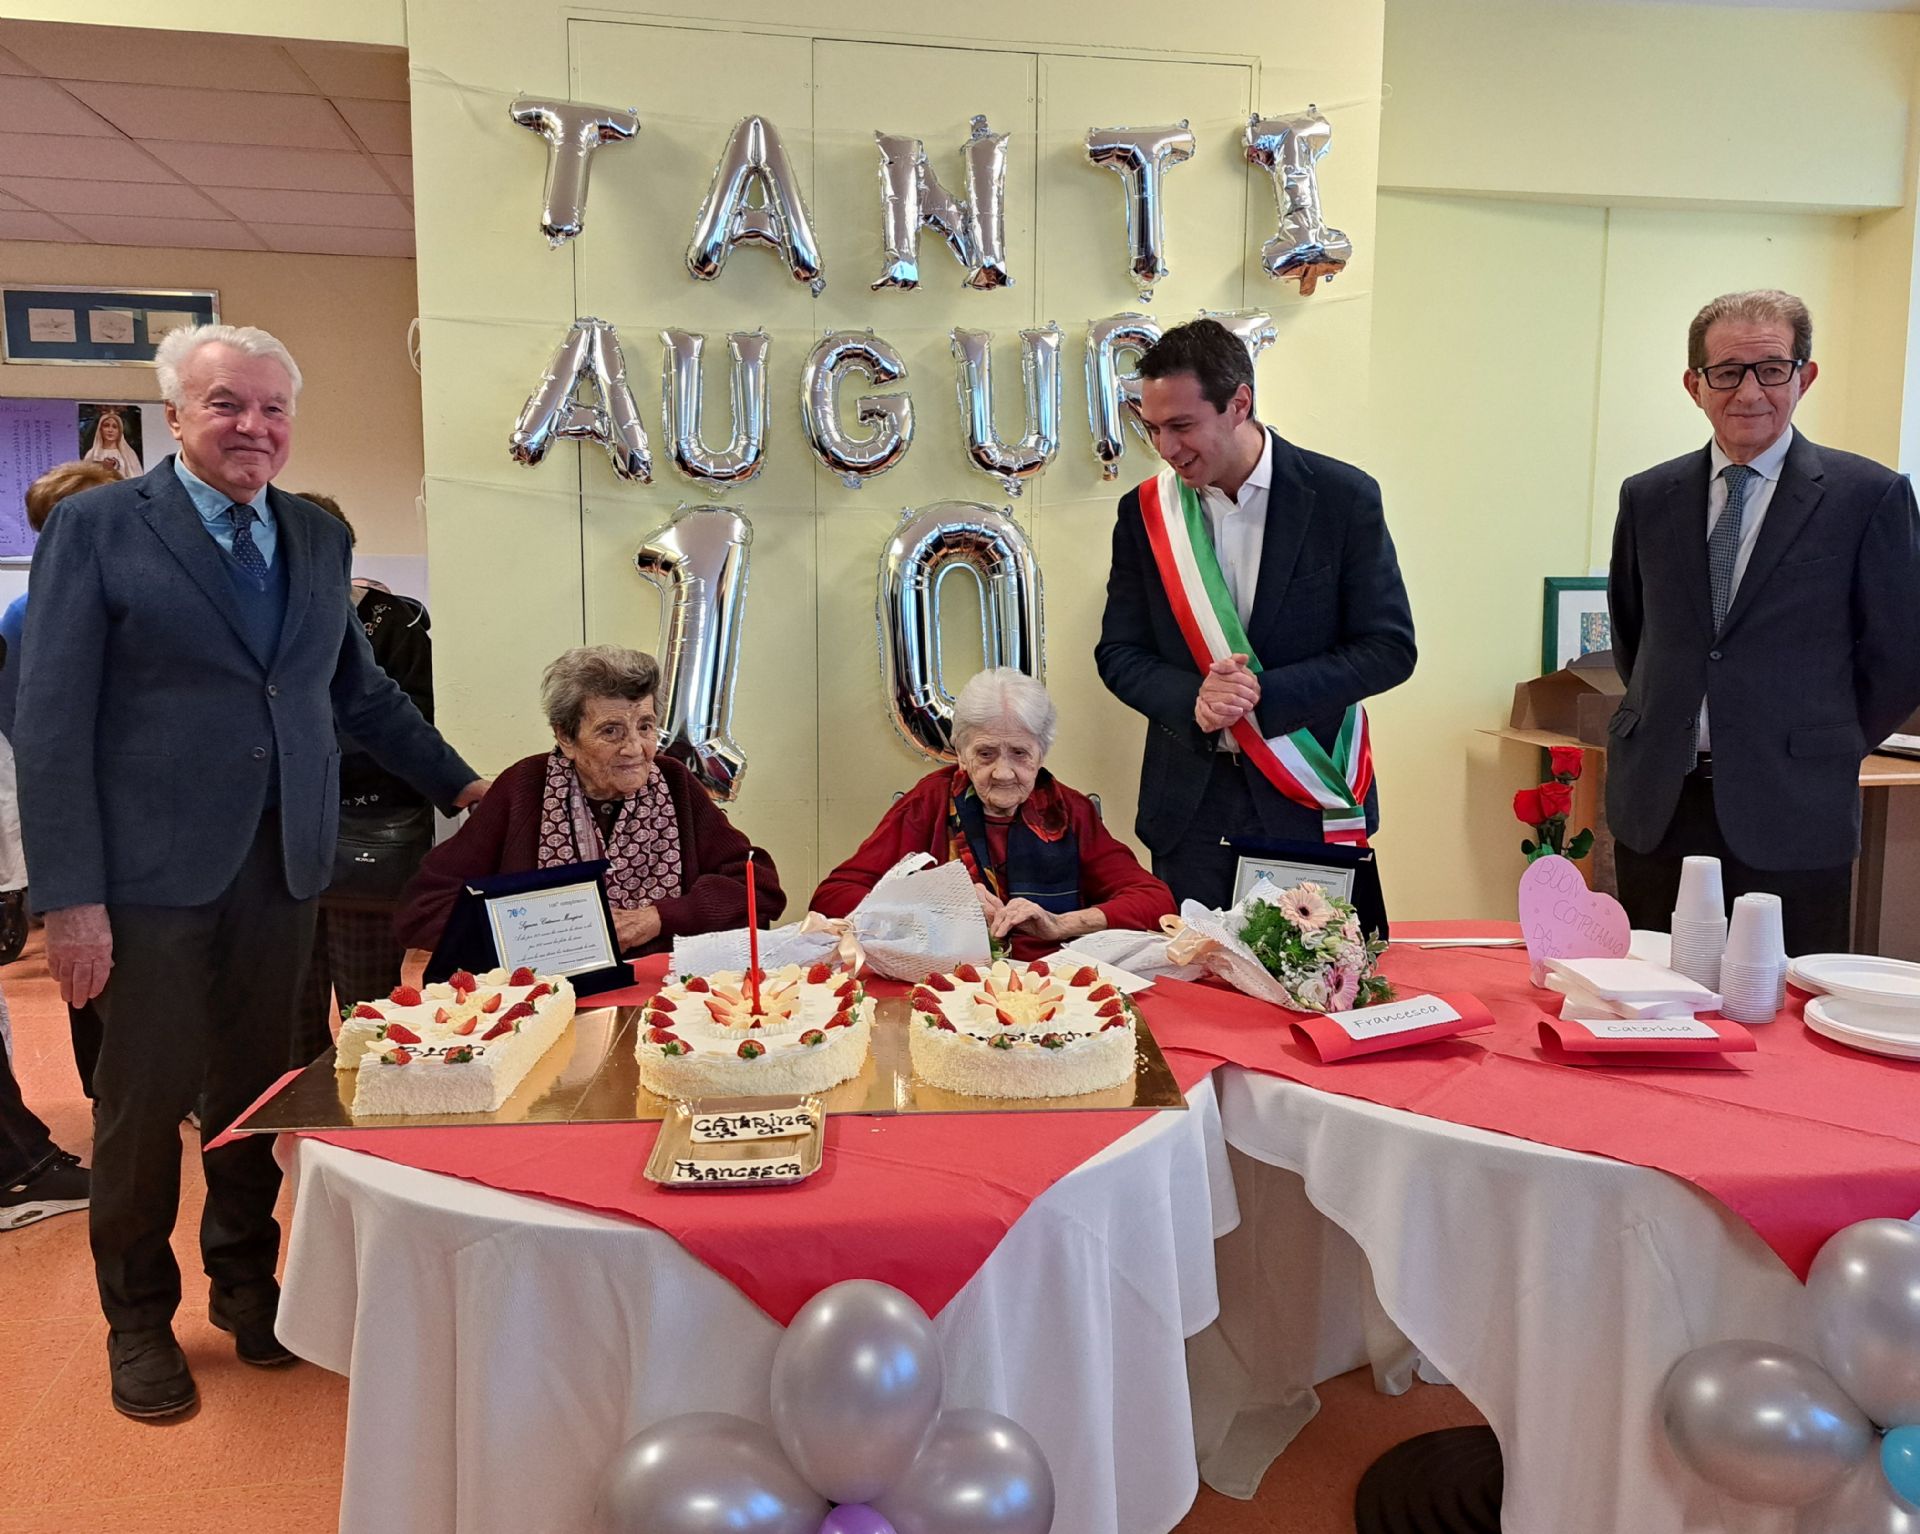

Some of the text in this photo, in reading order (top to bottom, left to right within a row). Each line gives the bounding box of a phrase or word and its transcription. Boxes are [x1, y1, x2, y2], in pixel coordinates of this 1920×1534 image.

[509, 93, 1352, 300] TANTI
[1534, 859, 1579, 898] BUON
[1353, 1004, 1440, 1028] Francesca
